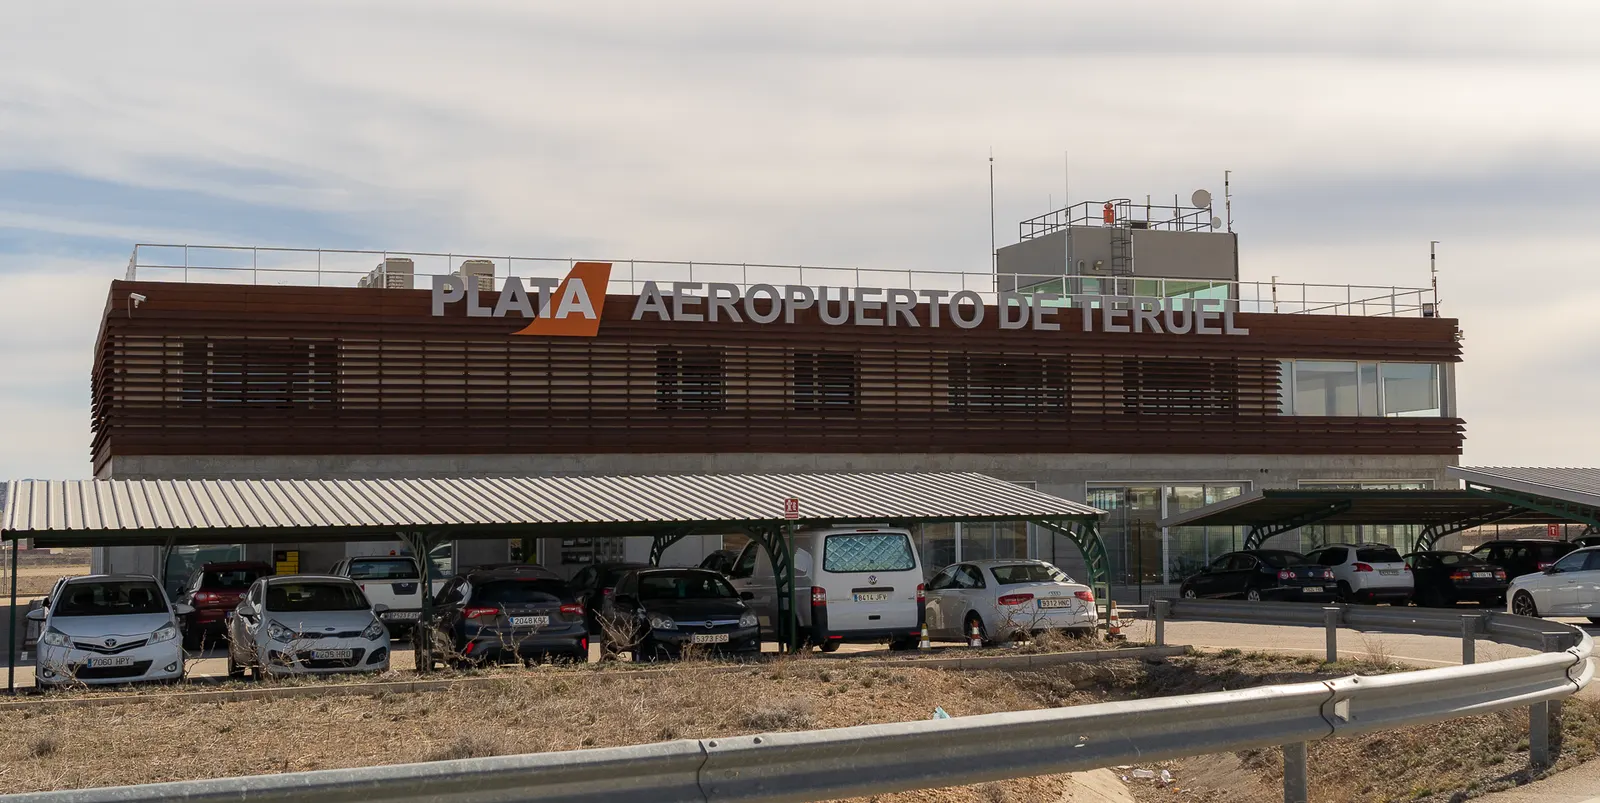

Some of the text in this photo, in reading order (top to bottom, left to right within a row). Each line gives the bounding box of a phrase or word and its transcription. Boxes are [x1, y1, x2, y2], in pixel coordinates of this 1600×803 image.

[432, 274, 1250, 336] PLATA AEROPUERTO DE TERUEL
[514, 617, 533, 625] 2048
[92, 657, 130, 667] 7060 HPY
